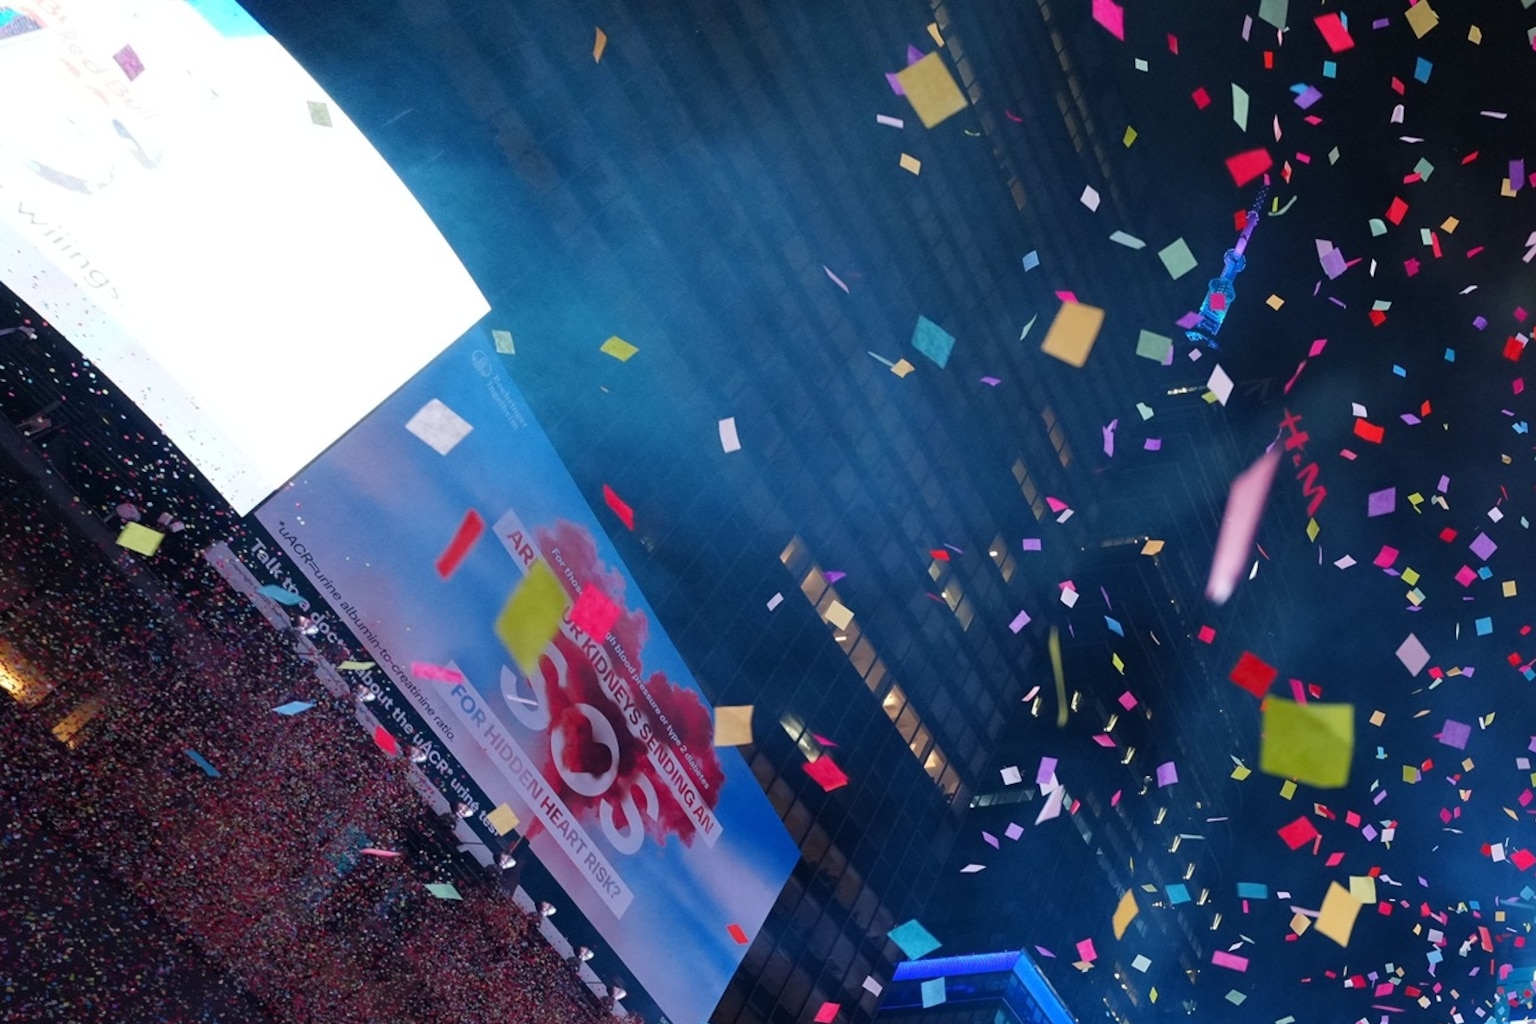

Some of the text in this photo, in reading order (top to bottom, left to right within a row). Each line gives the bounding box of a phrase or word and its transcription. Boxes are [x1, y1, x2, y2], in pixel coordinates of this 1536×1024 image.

[550, 547, 566, 568] For
[249, 537, 285, 581] Talk
[355, 666, 396, 712] about
[390, 705, 415, 736] the
[450, 776, 481, 817] urine
[339, 600, 436, 718] albumin-to-creatinine
[611, 642, 638, 676] blood
[506, 529, 536, 569] AR
[581, 633, 643, 727] KIDNEYS
[637, 719, 698, 810] SENDING
[691, 802, 716, 835] AN
[630, 671, 663, 718] pressure
[658, 713, 671, 727] or
[664, 722, 684, 746] type
[451, 683, 622, 900] FOR HIDDEN HEART RISK?
[683, 751, 712, 790] diabetes
